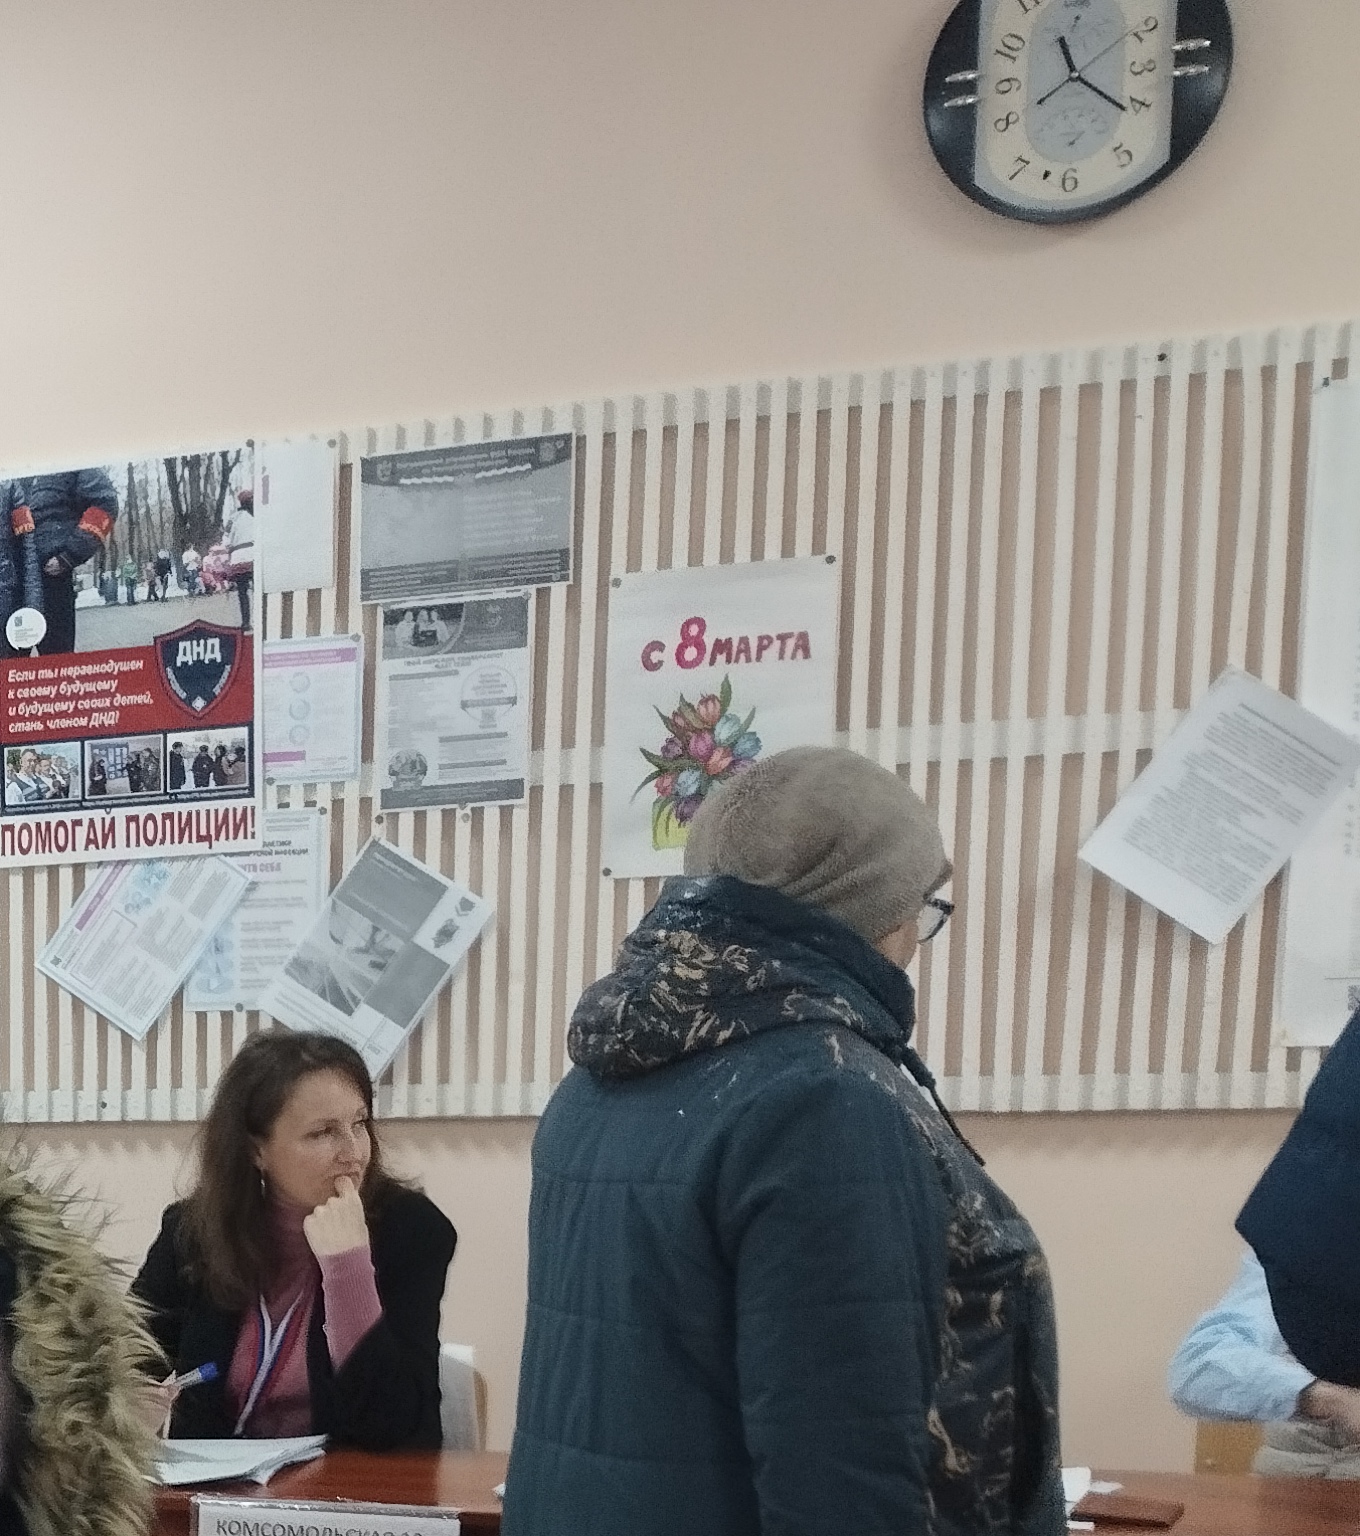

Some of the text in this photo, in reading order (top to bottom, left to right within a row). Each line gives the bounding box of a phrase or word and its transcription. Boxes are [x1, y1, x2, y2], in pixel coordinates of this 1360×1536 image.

[1129, 15, 1159, 43] 2
[994, 32, 1026, 63] 10
[1130, 58, 1157, 76] 3
[994, 76, 1022, 95] 9
[1129, 94, 1153, 114] 4
[993, 110, 1020, 132] 8
[1112, 142, 1133, 168] 5
[1009, 154, 1030, 180] 7
[1061, 168, 1079, 192] 6
[176, 637, 221, 666] ДНД
[674, 616, 707, 669] 8
[709, 630, 812, 666] МАРТА
[8, 660, 143, 682] Если ты неравнодушен
[8, 680, 118, 699] к своему будущему
[8, 706, 16, 717] и
[18, 700, 76, 717] будущему
[77, 697, 111, 711] своих
[8, 721, 44, 733] стань
[46, 716, 88, 729] членом
[0, 805, 256, 857] ПОМОГАЙ ПОЛИЦИИ!
